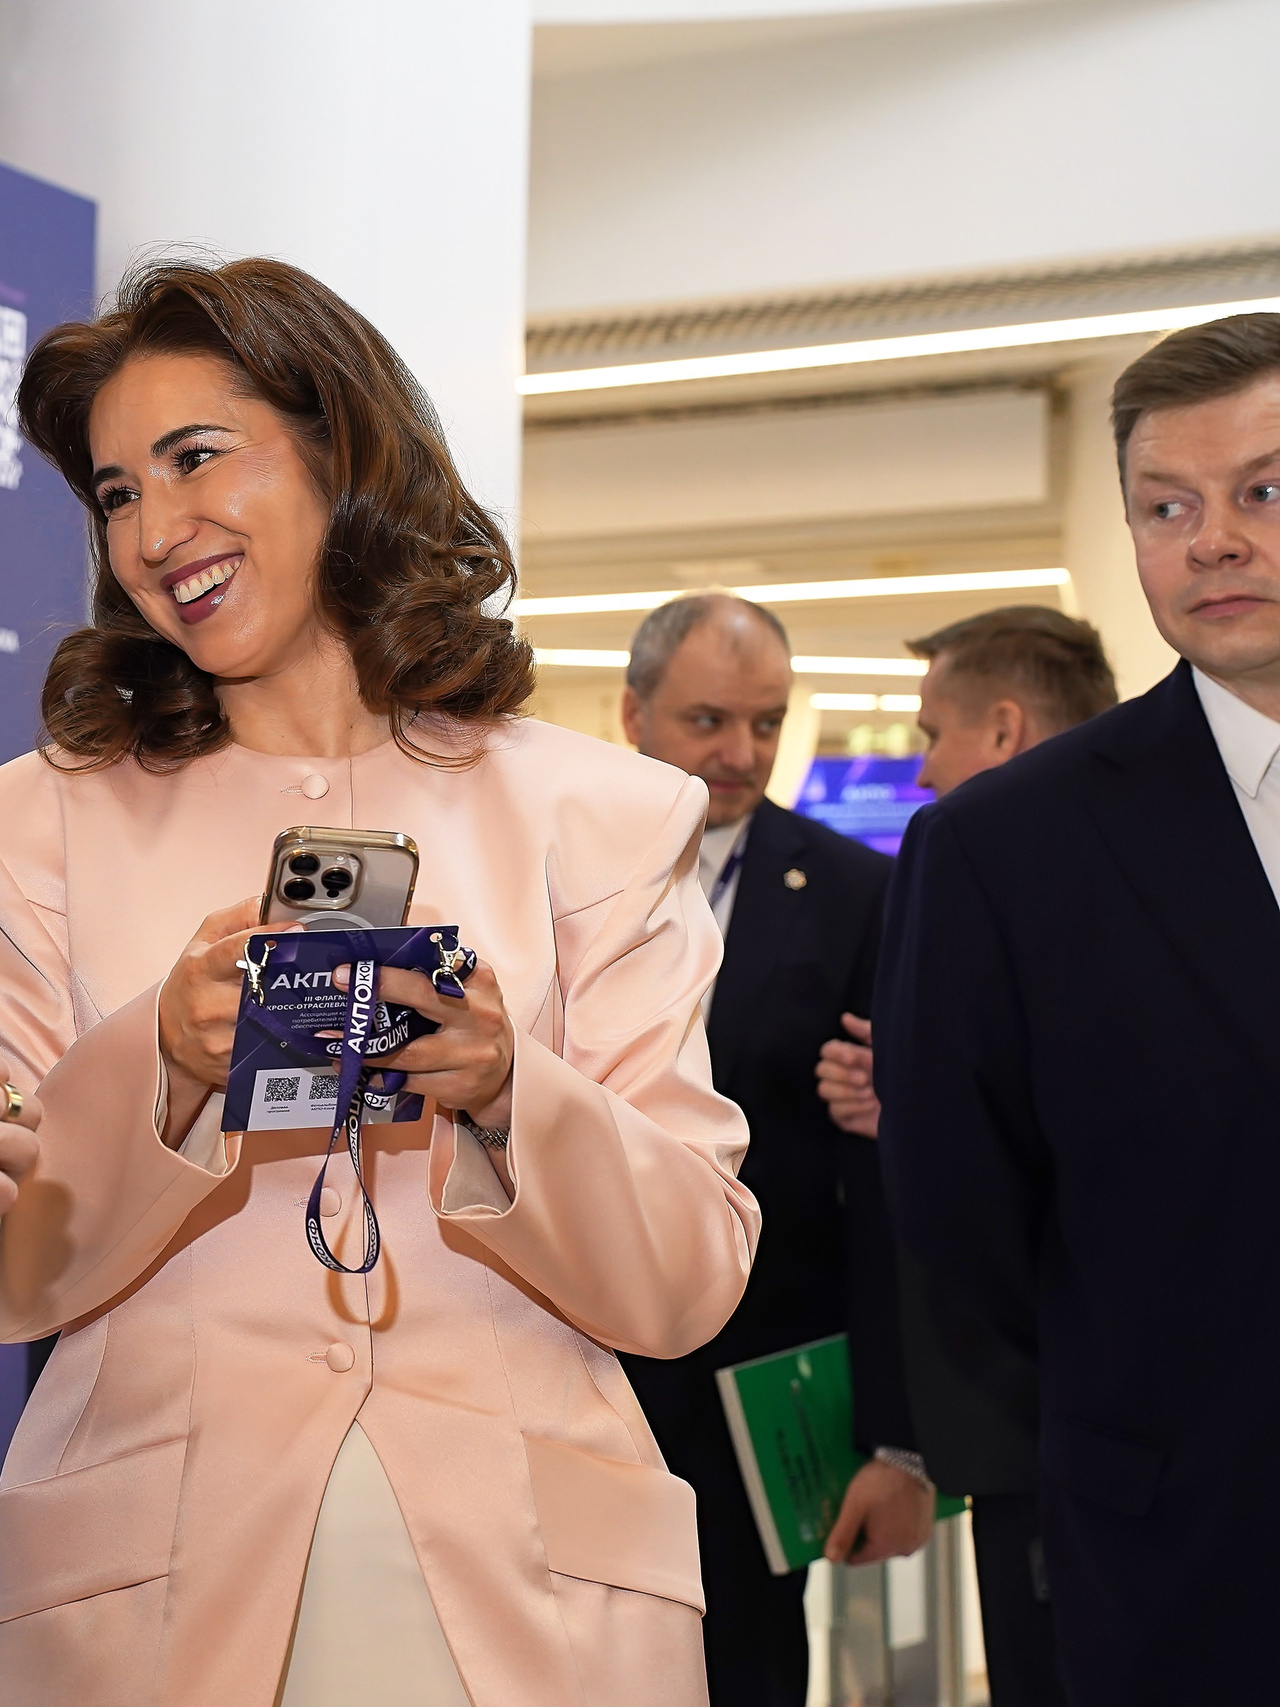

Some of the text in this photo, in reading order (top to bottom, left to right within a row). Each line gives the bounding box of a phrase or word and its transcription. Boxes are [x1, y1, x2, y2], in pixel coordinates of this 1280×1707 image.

[270, 970, 332, 990] АКП
[314, 994, 348, 1002] ФЛАГМ
[267, 1002, 348, 1011] КРОСС-ОТРАСЛЕВА
